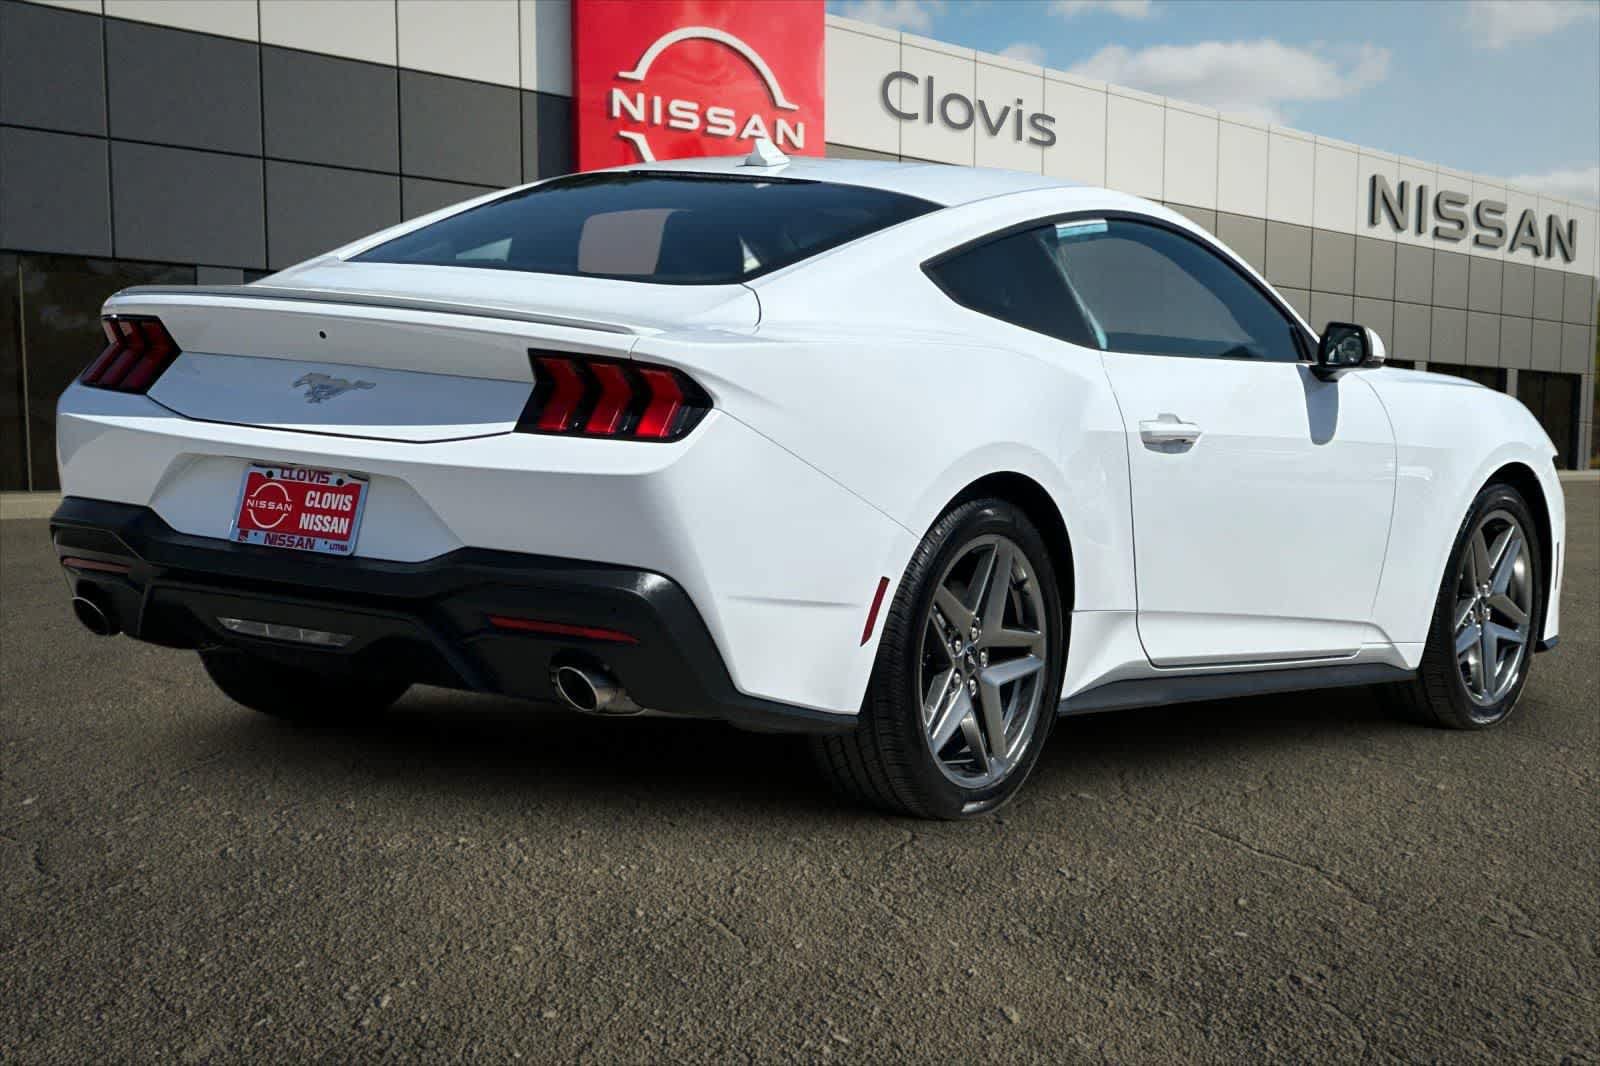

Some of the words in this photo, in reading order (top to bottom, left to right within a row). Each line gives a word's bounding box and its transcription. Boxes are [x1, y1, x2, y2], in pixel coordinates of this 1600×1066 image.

[610, 88, 806, 149] NISSAN
[881, 71, 1057, 147] Clovis
[1369, 174, 1577, 263] NISSAN
[281, 467, 332, 484] CLOVIS
[246, 499, 292, 512] NISSAN
[305, 490, 353, 511] CLOVIS
[299, 513, 350, 535] NISSAN
[263, 533, 316, 550] NISSAN
